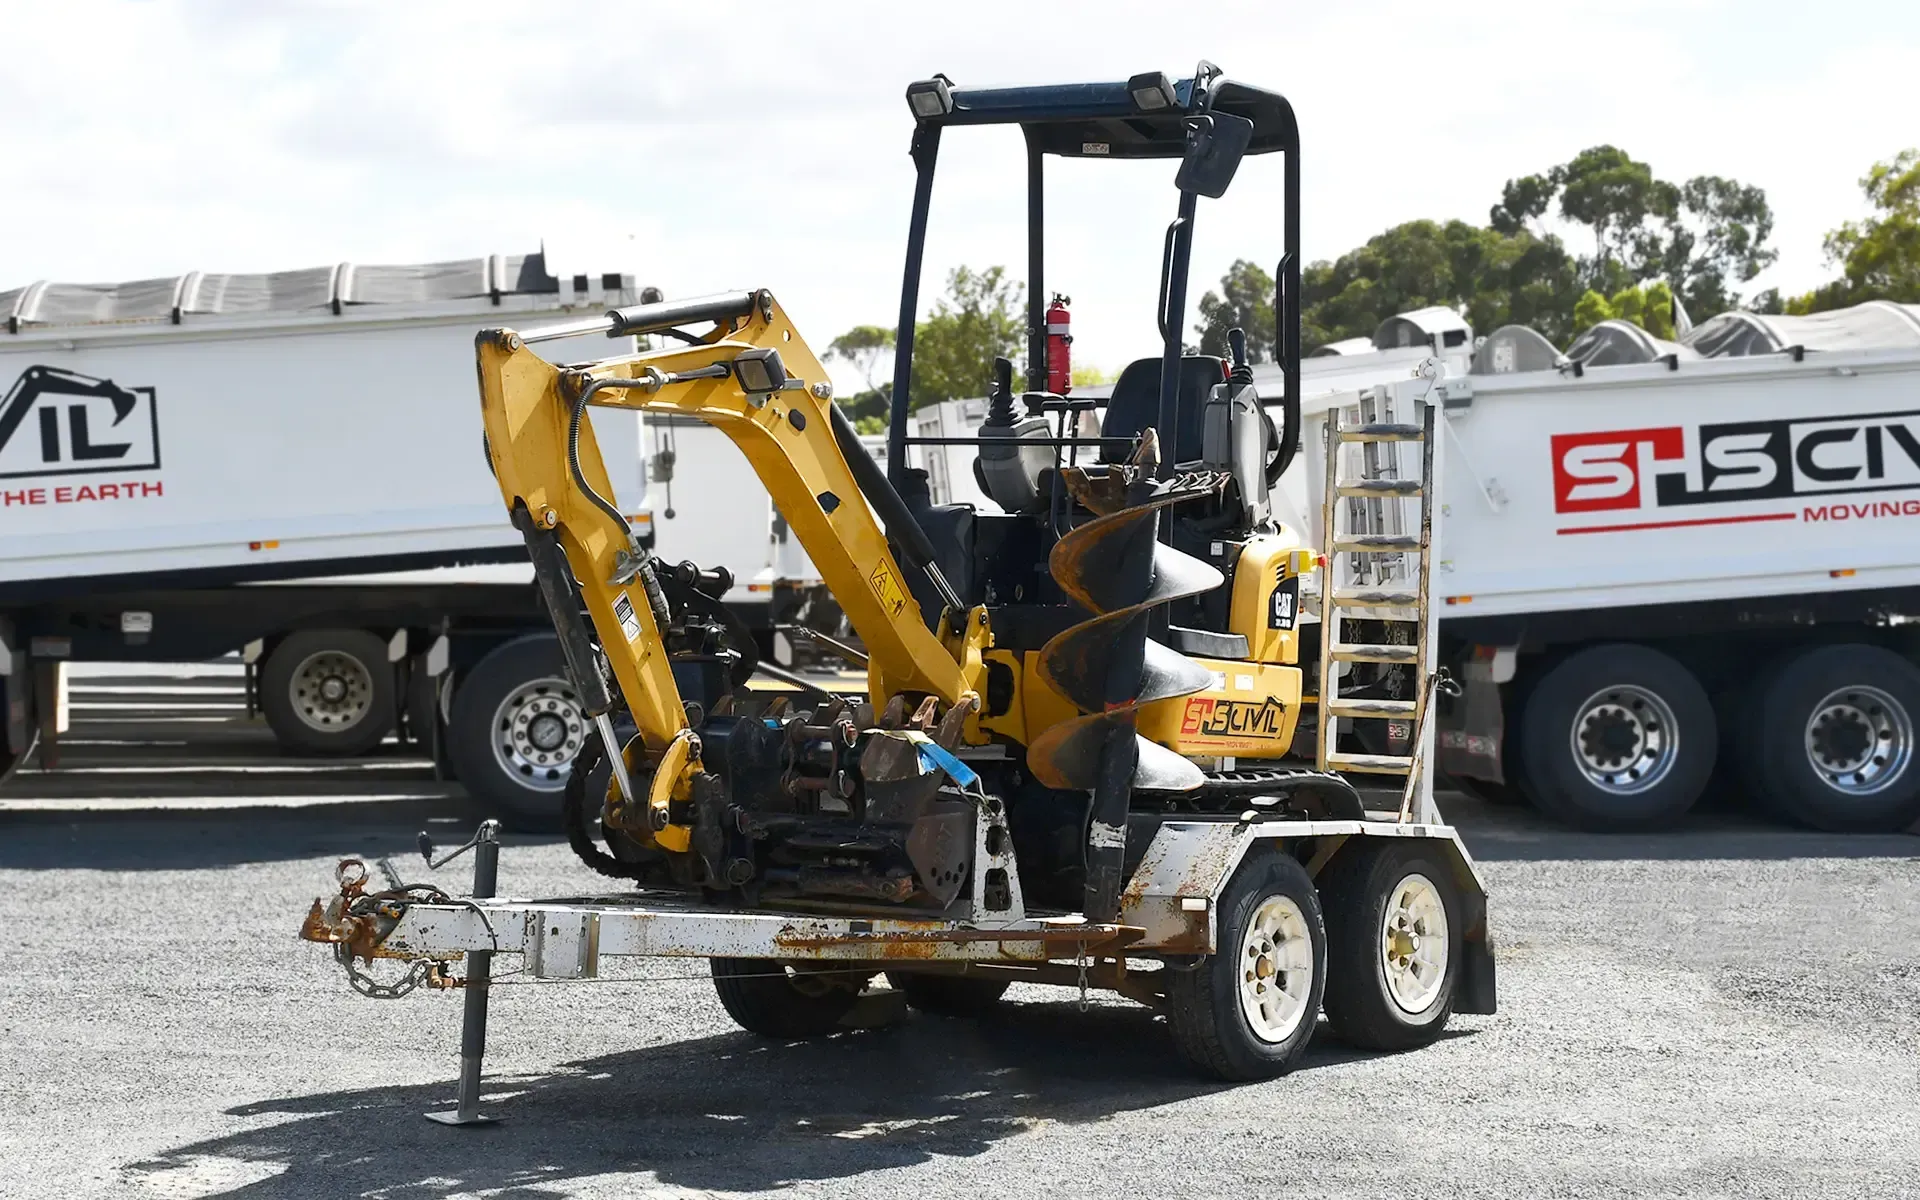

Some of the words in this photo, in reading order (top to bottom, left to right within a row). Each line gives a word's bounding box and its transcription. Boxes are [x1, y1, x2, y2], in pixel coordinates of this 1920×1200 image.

[0, 488, 46, 506] HE
[54, 481, 163, 503] EARTH
[1803, 500, 1920, 522] MOVING
[1275, 591, 1293, 618] CAT
